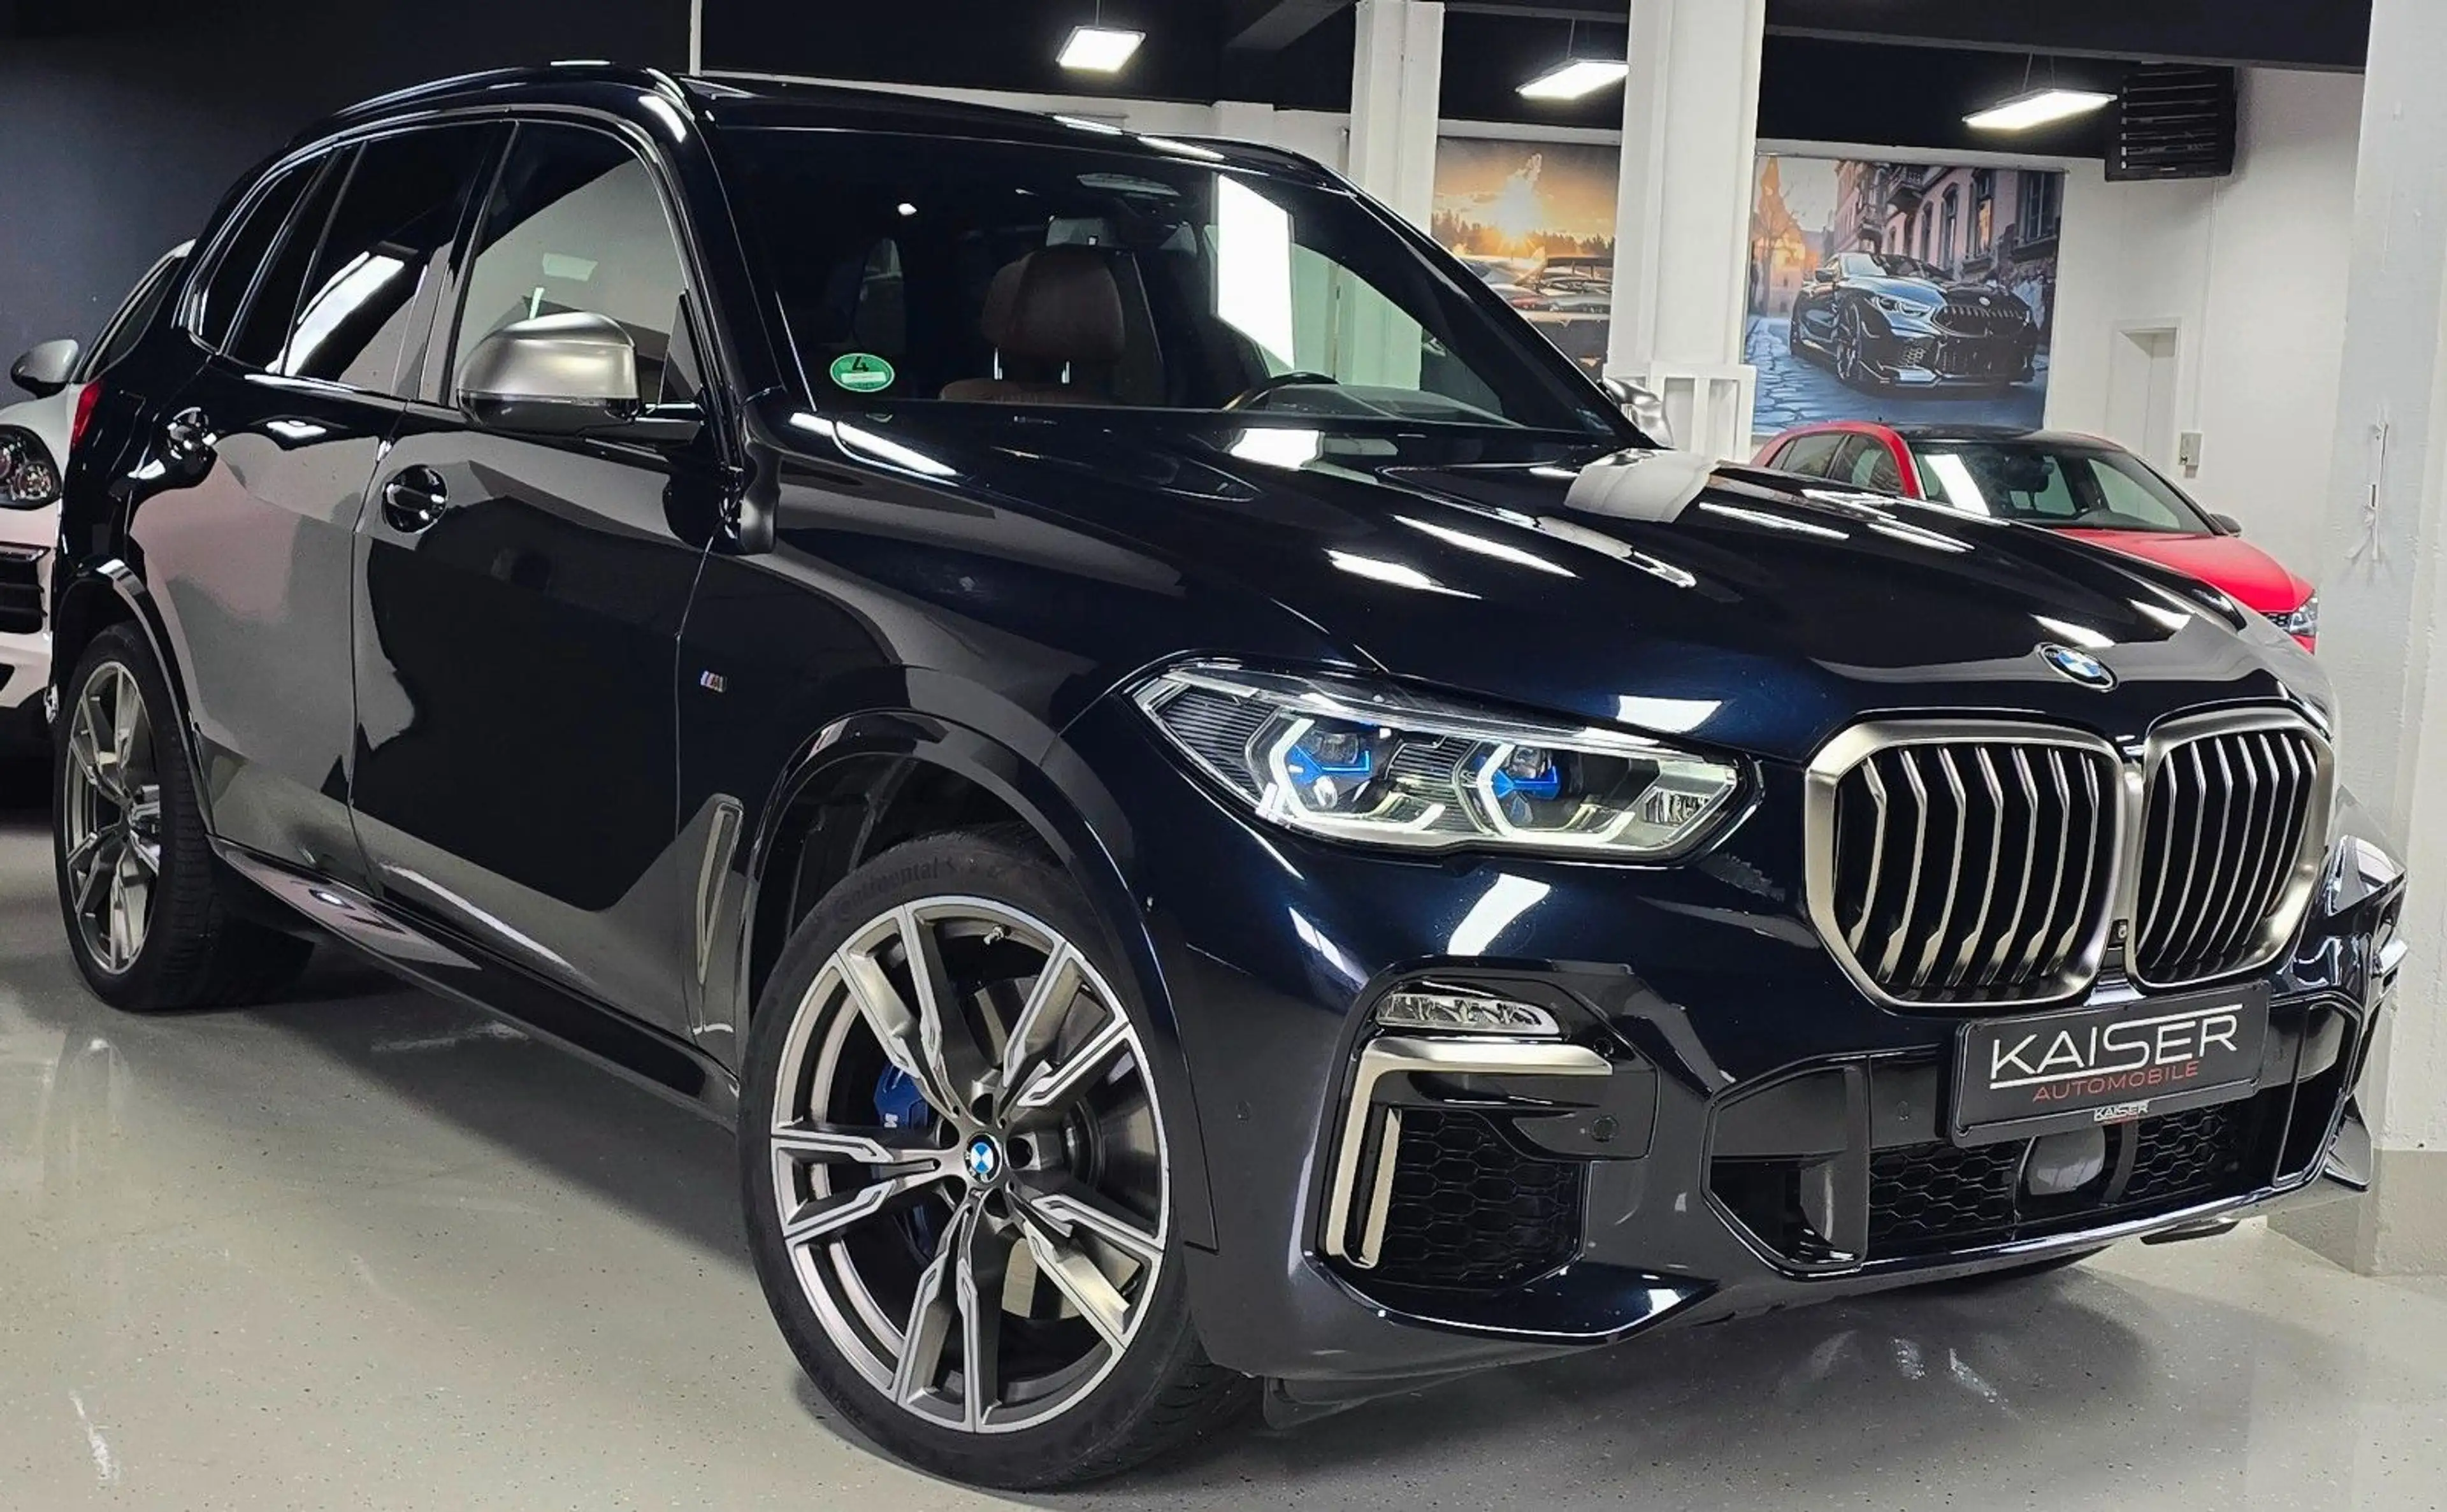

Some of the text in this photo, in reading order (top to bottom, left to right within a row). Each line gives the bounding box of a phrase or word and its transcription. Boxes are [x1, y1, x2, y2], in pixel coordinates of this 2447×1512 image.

[852, 356, 869, 372] 4
[1990, 1005, 2242, 1088] KAISER
[2032, 1061, 2199, 1103] AUTOMOBILE
[2094, 1101, 2148, 1121] KAISER
